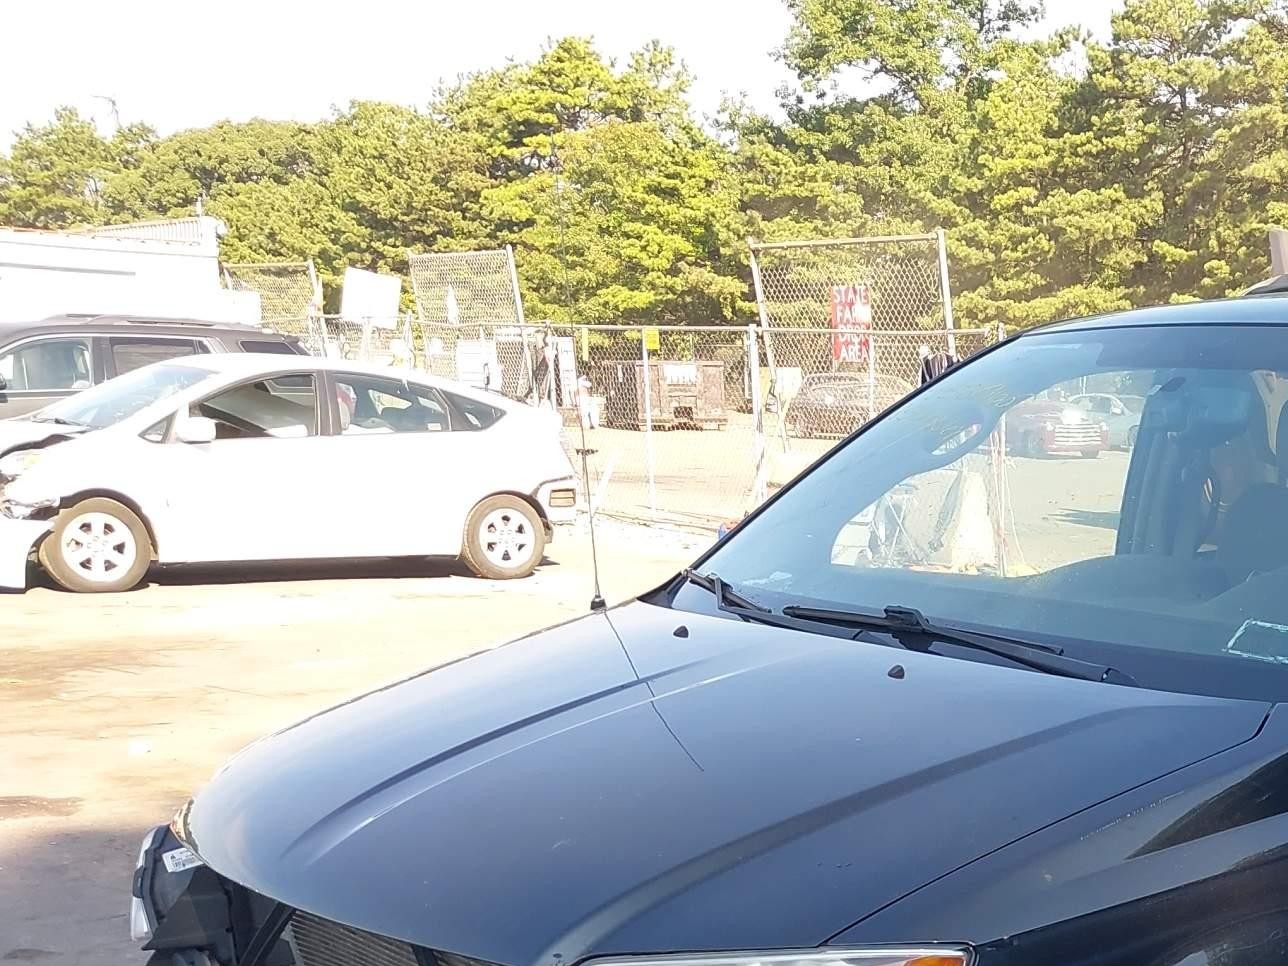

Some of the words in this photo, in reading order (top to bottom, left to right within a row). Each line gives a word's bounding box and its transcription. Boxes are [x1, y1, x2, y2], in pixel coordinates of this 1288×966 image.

[833, 286, 870, 304] STATE
[837, 305, 869, 322] FAR
[840, 344, 870, 363] AREA
